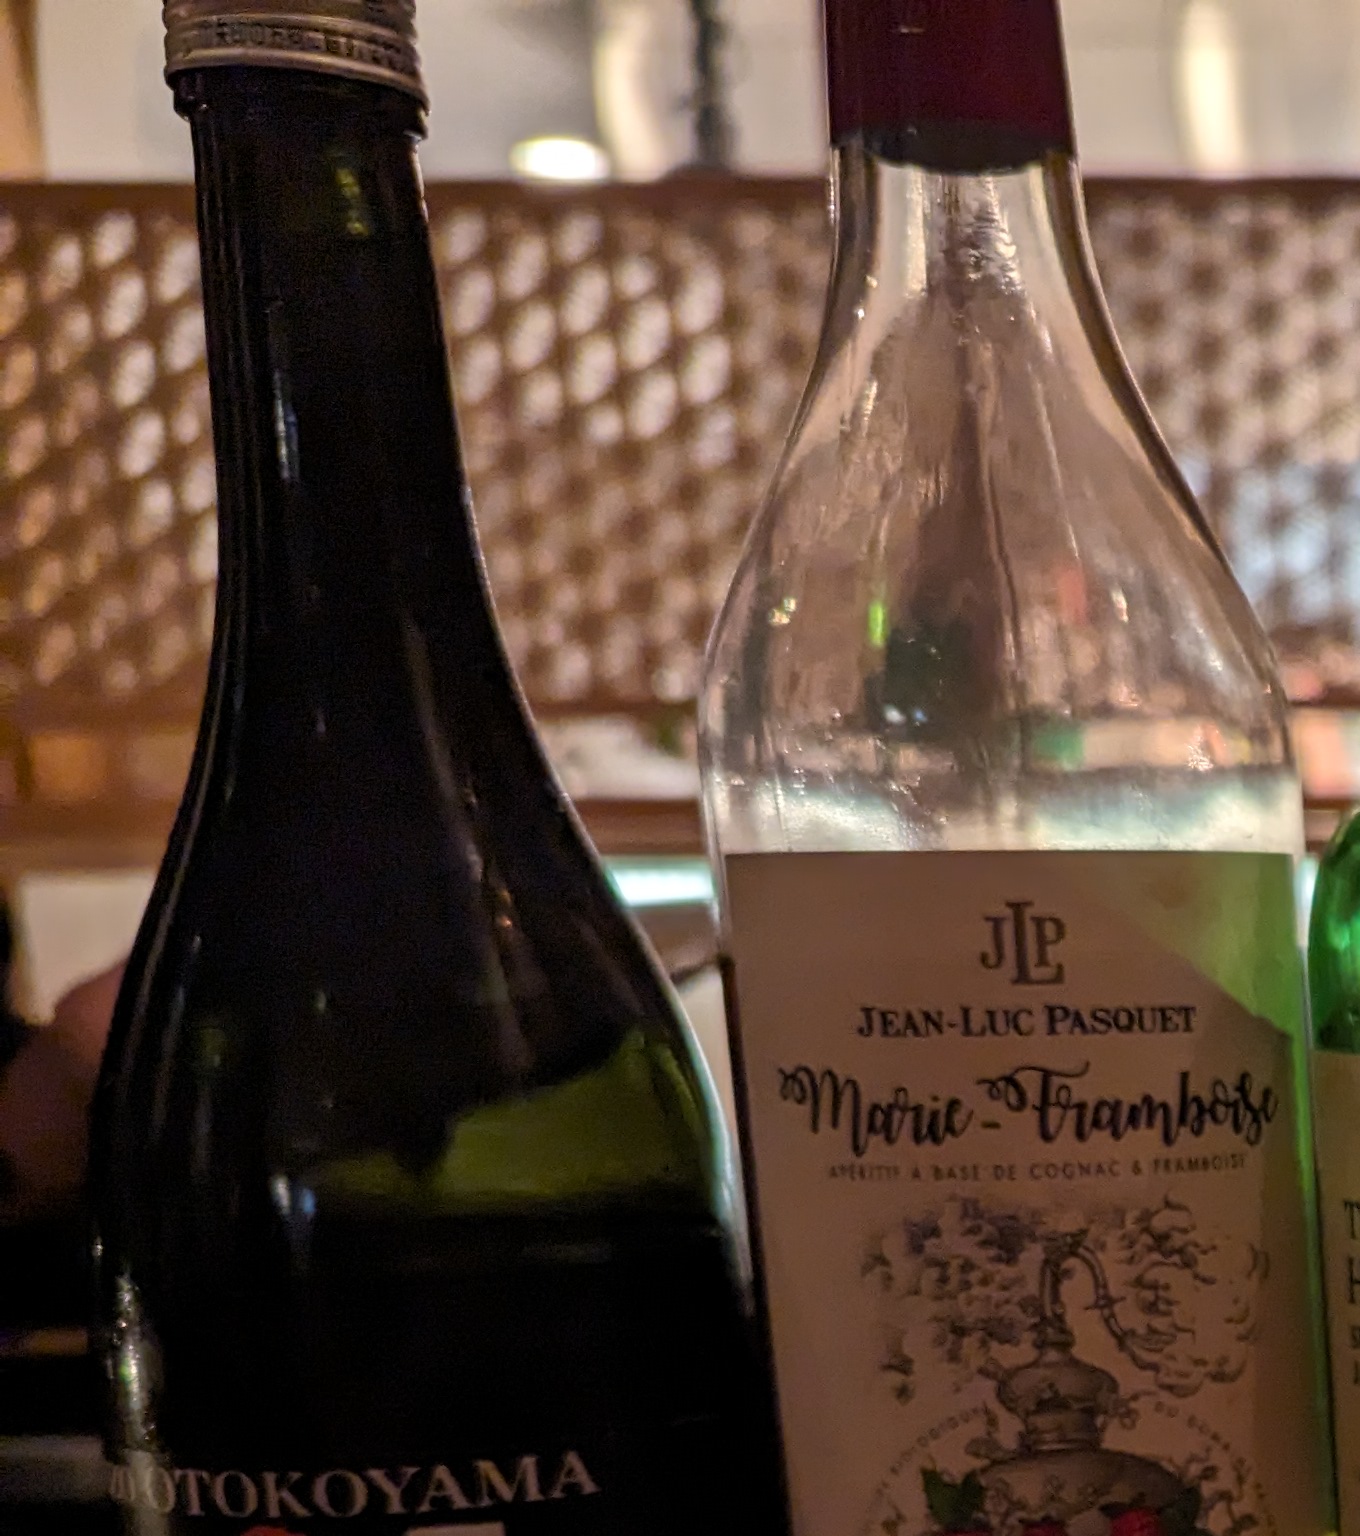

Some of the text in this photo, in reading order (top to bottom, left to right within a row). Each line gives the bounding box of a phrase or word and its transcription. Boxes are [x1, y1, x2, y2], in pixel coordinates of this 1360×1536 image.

[857, 1004, 1197, 1039] JEAN-LUC PASQUET
[993, 1164, 1017, 1182] DE
[1029, 1158, 1120, 1181] COGNAC
